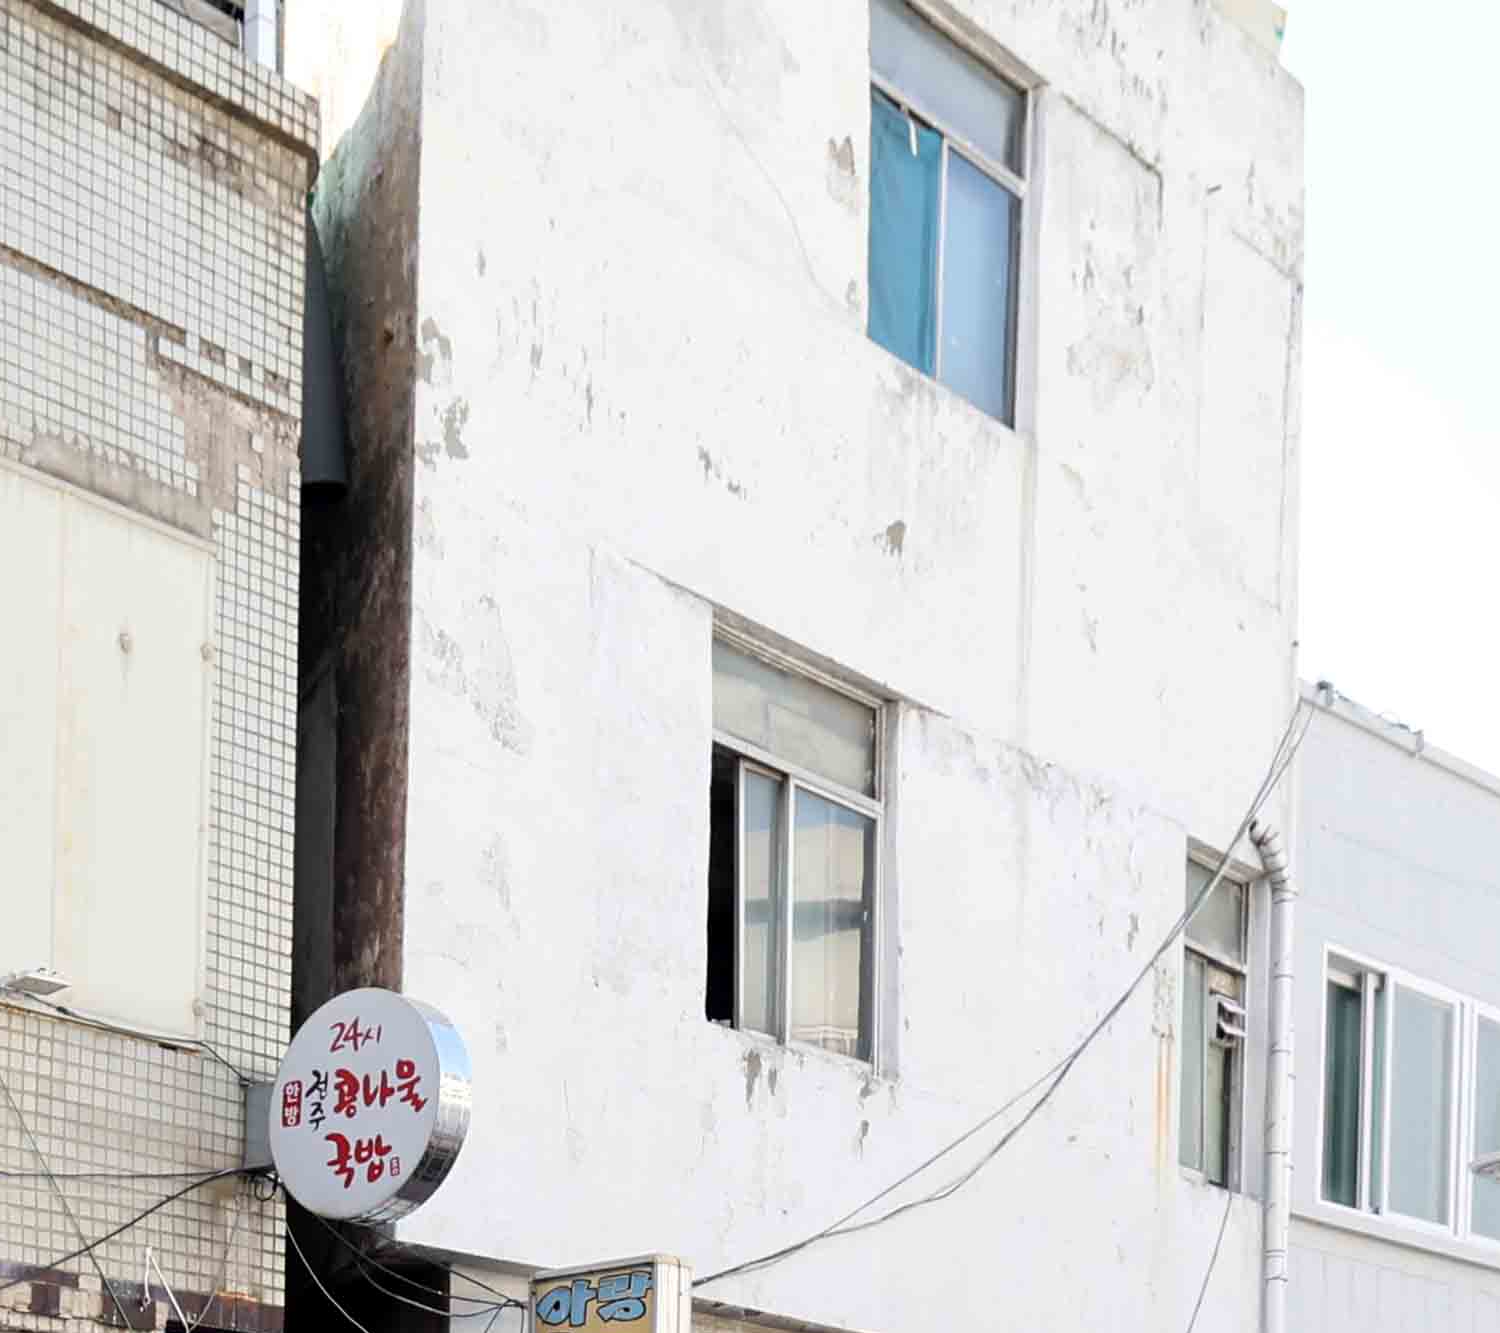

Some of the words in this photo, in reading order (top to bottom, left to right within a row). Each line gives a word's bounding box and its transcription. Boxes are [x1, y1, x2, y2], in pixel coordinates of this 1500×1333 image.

[329, 1016, 382, 1052] 24시
[305, 1069, 329, 1131] 전주
[333, 1059, 429, 1119] 콩나물
[536, 1271, 653, 1328] 아랑
